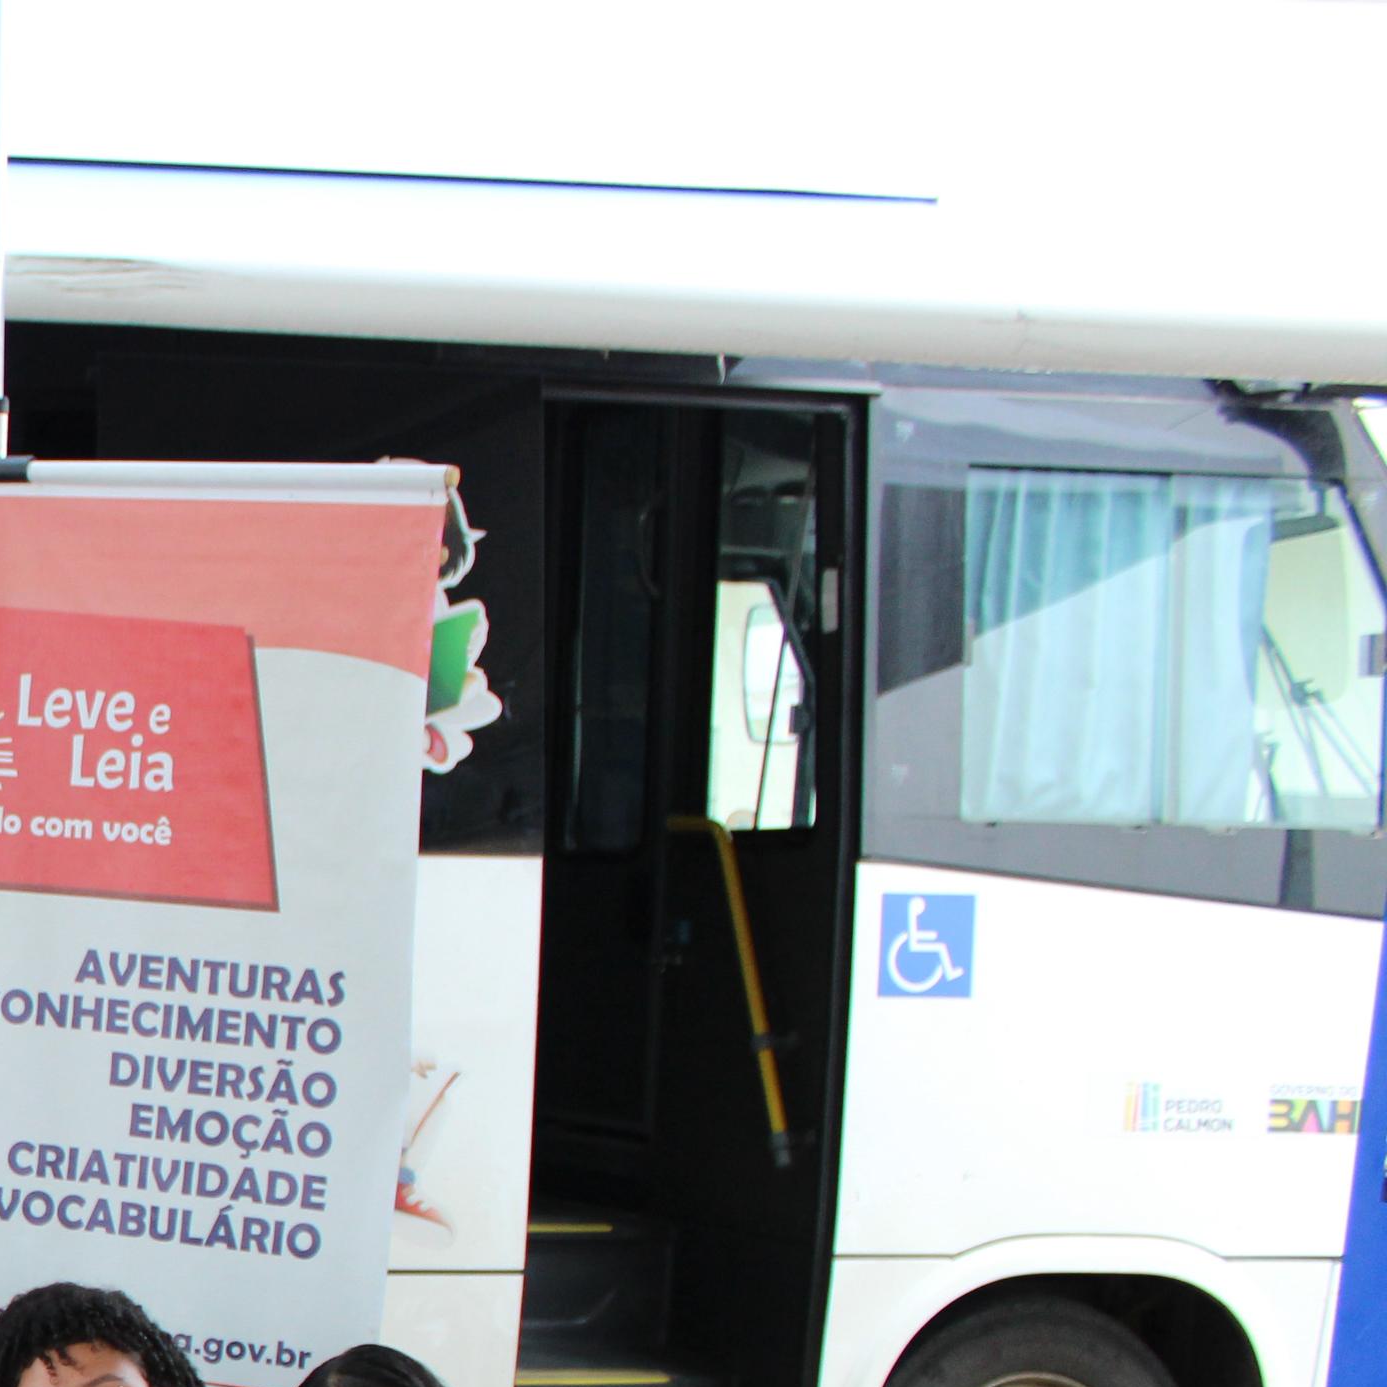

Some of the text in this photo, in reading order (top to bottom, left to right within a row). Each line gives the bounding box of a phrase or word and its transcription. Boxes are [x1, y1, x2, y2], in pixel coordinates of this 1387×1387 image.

[17, 673, 172, 735] Leve e
[70, 735, 174, 793] Leia
[30, 816, 93, 840] com
[102, 814, 173, 847] você
[74, 947, 346, 1008] AVENTURAS
[108, 1050, 337, 1110] DIVERSÃO
[1164, 1098, 1223, 1114] PEDRO
[127, 1103, 333, 1159] EMOÇÃO
[1163, 1118, 1235, 1133] CALMON
[1268, 1099, 1359, 1134] BAH
[6, 1141, 328, 1213] CRIATIVIDADE
[173, 1332, 312, 1369] a.gov.br
